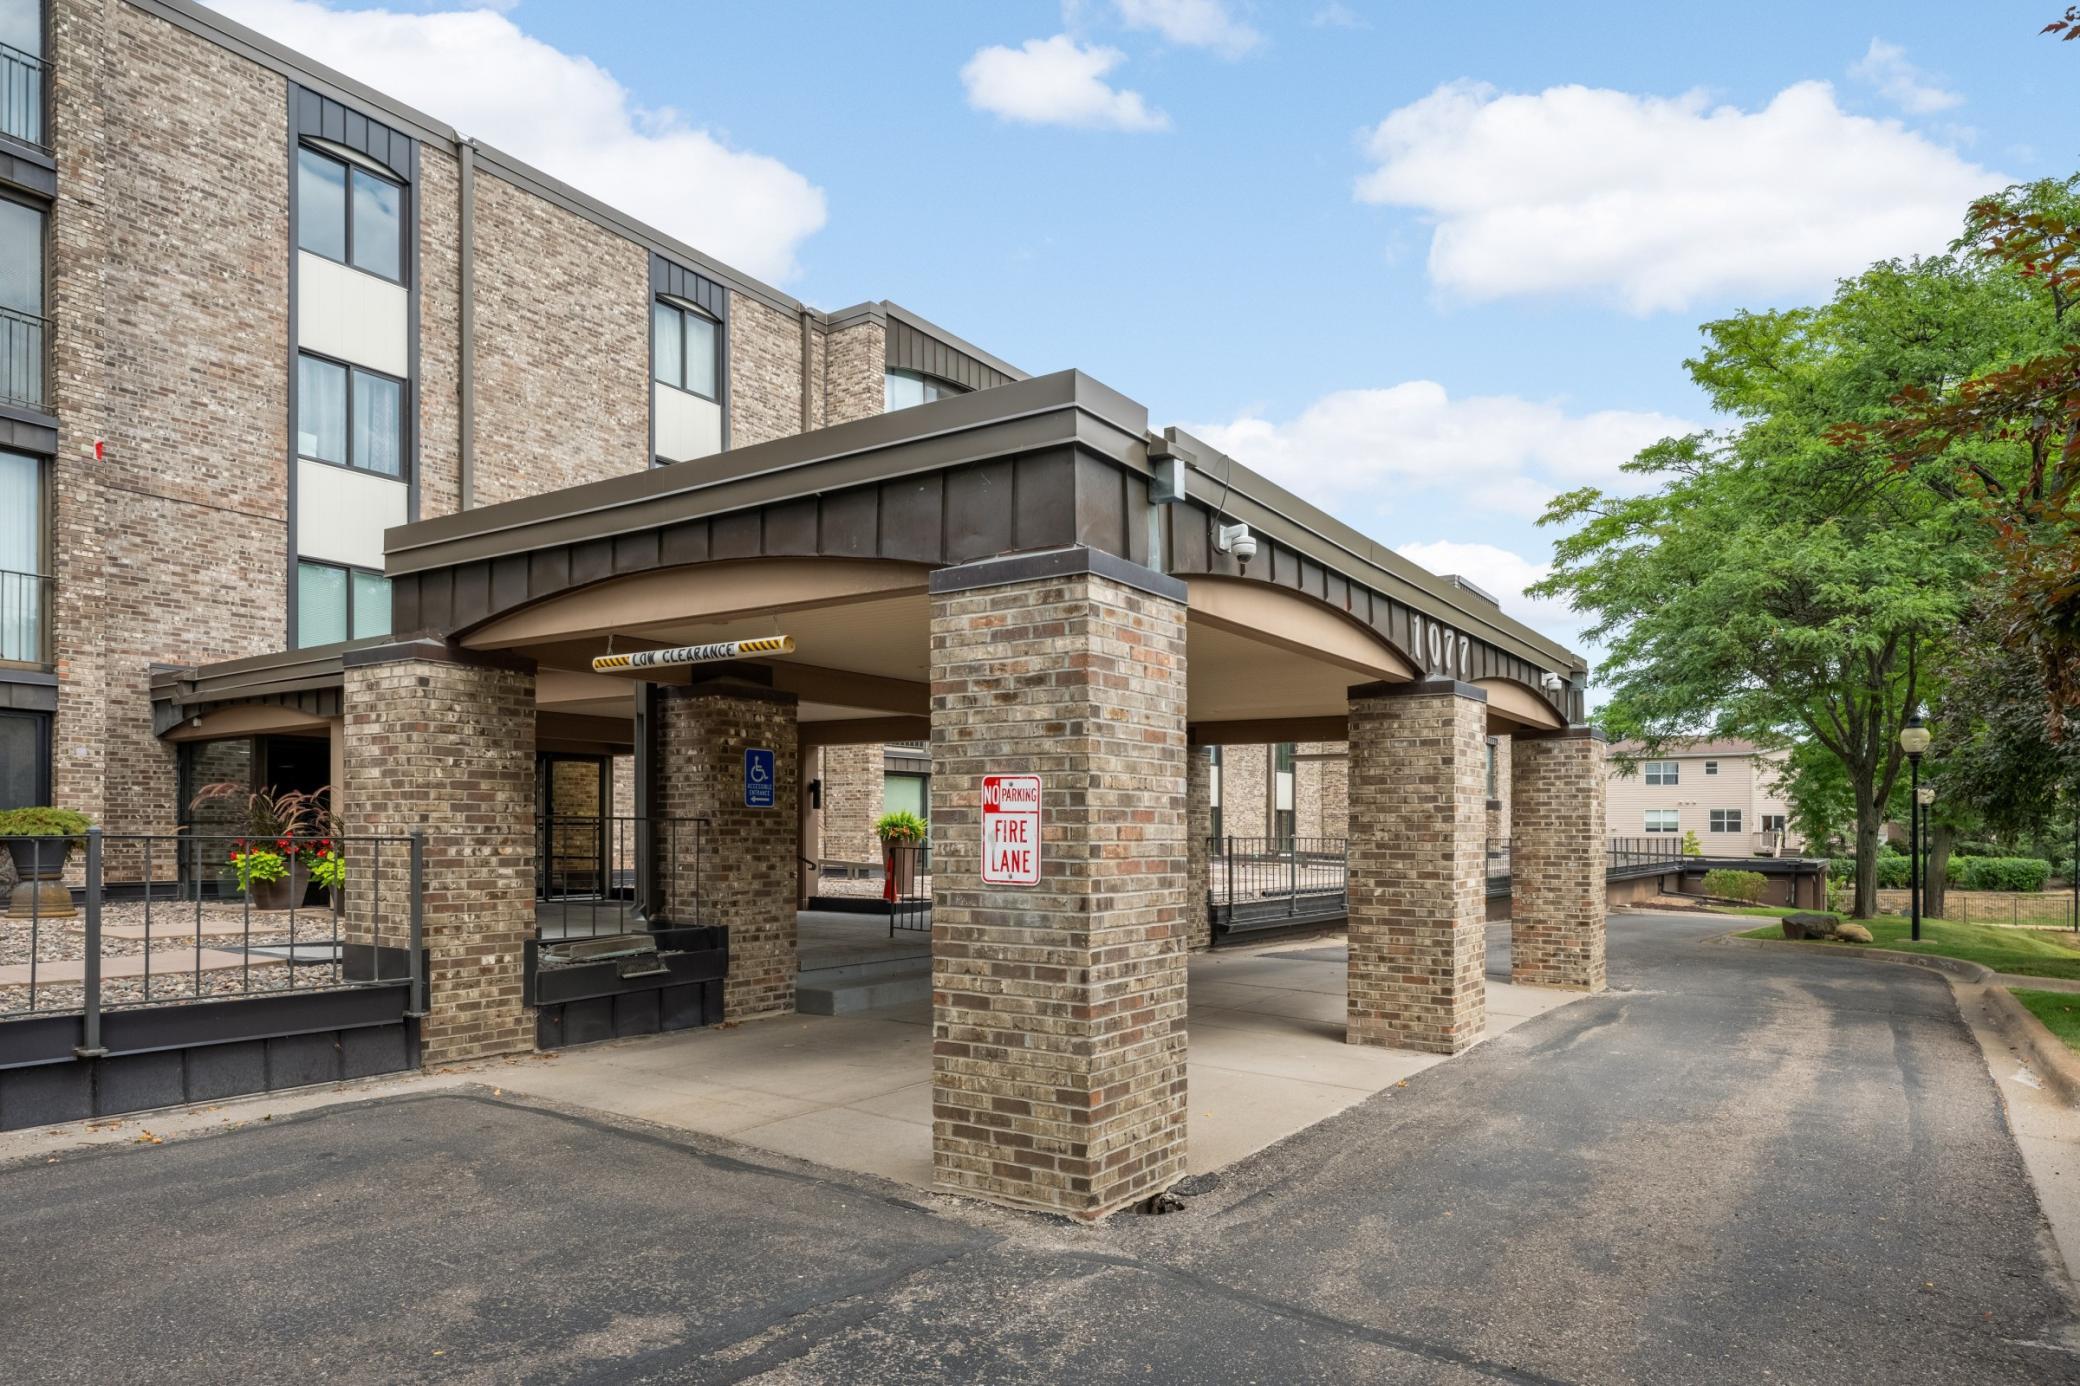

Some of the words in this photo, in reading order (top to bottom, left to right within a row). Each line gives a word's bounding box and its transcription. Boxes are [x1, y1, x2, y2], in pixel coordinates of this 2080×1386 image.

[632, 653, 655, 667] LOW
[662, 643, 736, 663] CLEARANCE
[1414, 614, 1470, 675] 1077
[984, 785, 999, 805] NO
[1001, 787, 1037, 803] PARKING
[994, 819, 1028, 843] FIRE
[991, 849, 1031, 873] LANE
